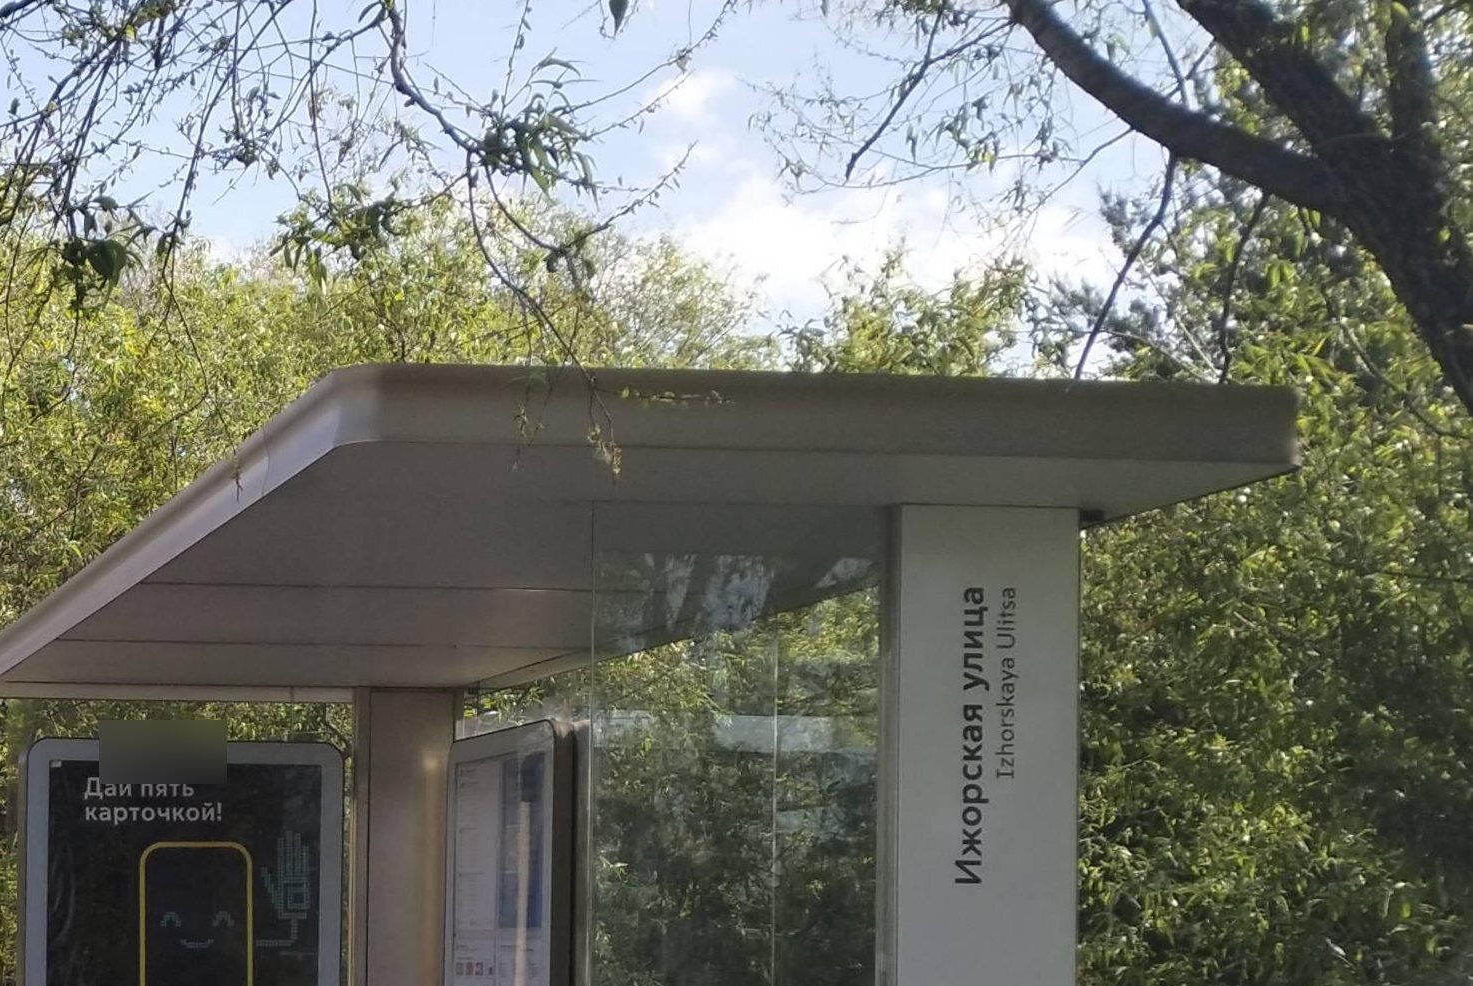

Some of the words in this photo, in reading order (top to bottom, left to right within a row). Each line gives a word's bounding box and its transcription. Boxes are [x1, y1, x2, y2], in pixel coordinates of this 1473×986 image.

[963, 586, 990, 692] улица
[995, 586, 1017, 649] Ulitsa
[994, 656, 1020, 779] Izhorskaya
[84, 801, 223, 826] карточкой!
[140, 783, 195, 798] пять
[954, 703, 990, 884] Ижорская
